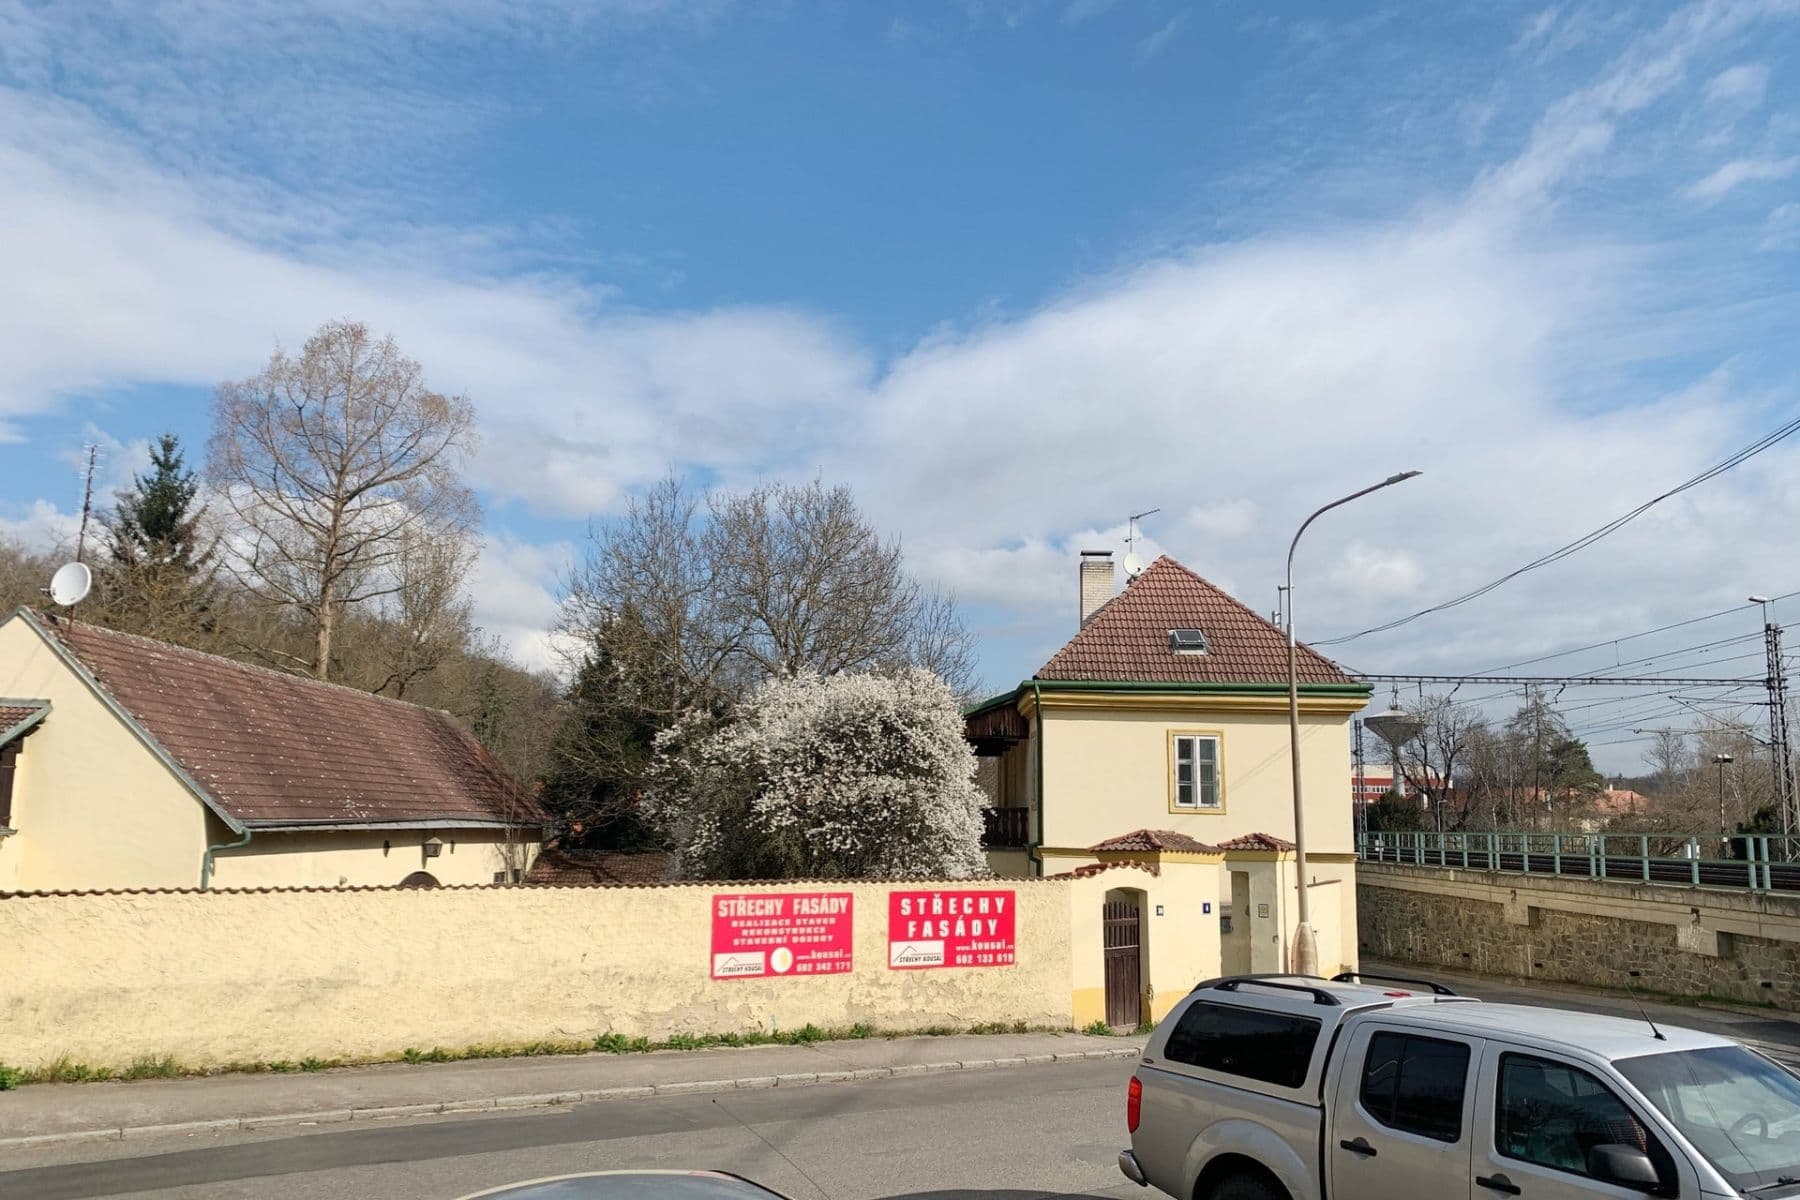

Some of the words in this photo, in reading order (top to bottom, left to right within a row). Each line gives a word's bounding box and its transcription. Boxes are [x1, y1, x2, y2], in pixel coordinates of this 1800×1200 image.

[718, 896, 784, 918] STŘECHY
[793, 894, 849, 915] FASÁDY
[900, 893, 1005, 916] STŘECHY
[907, 914, 998, 938] FASÁDY
[956, 954, 973, 964] 602
